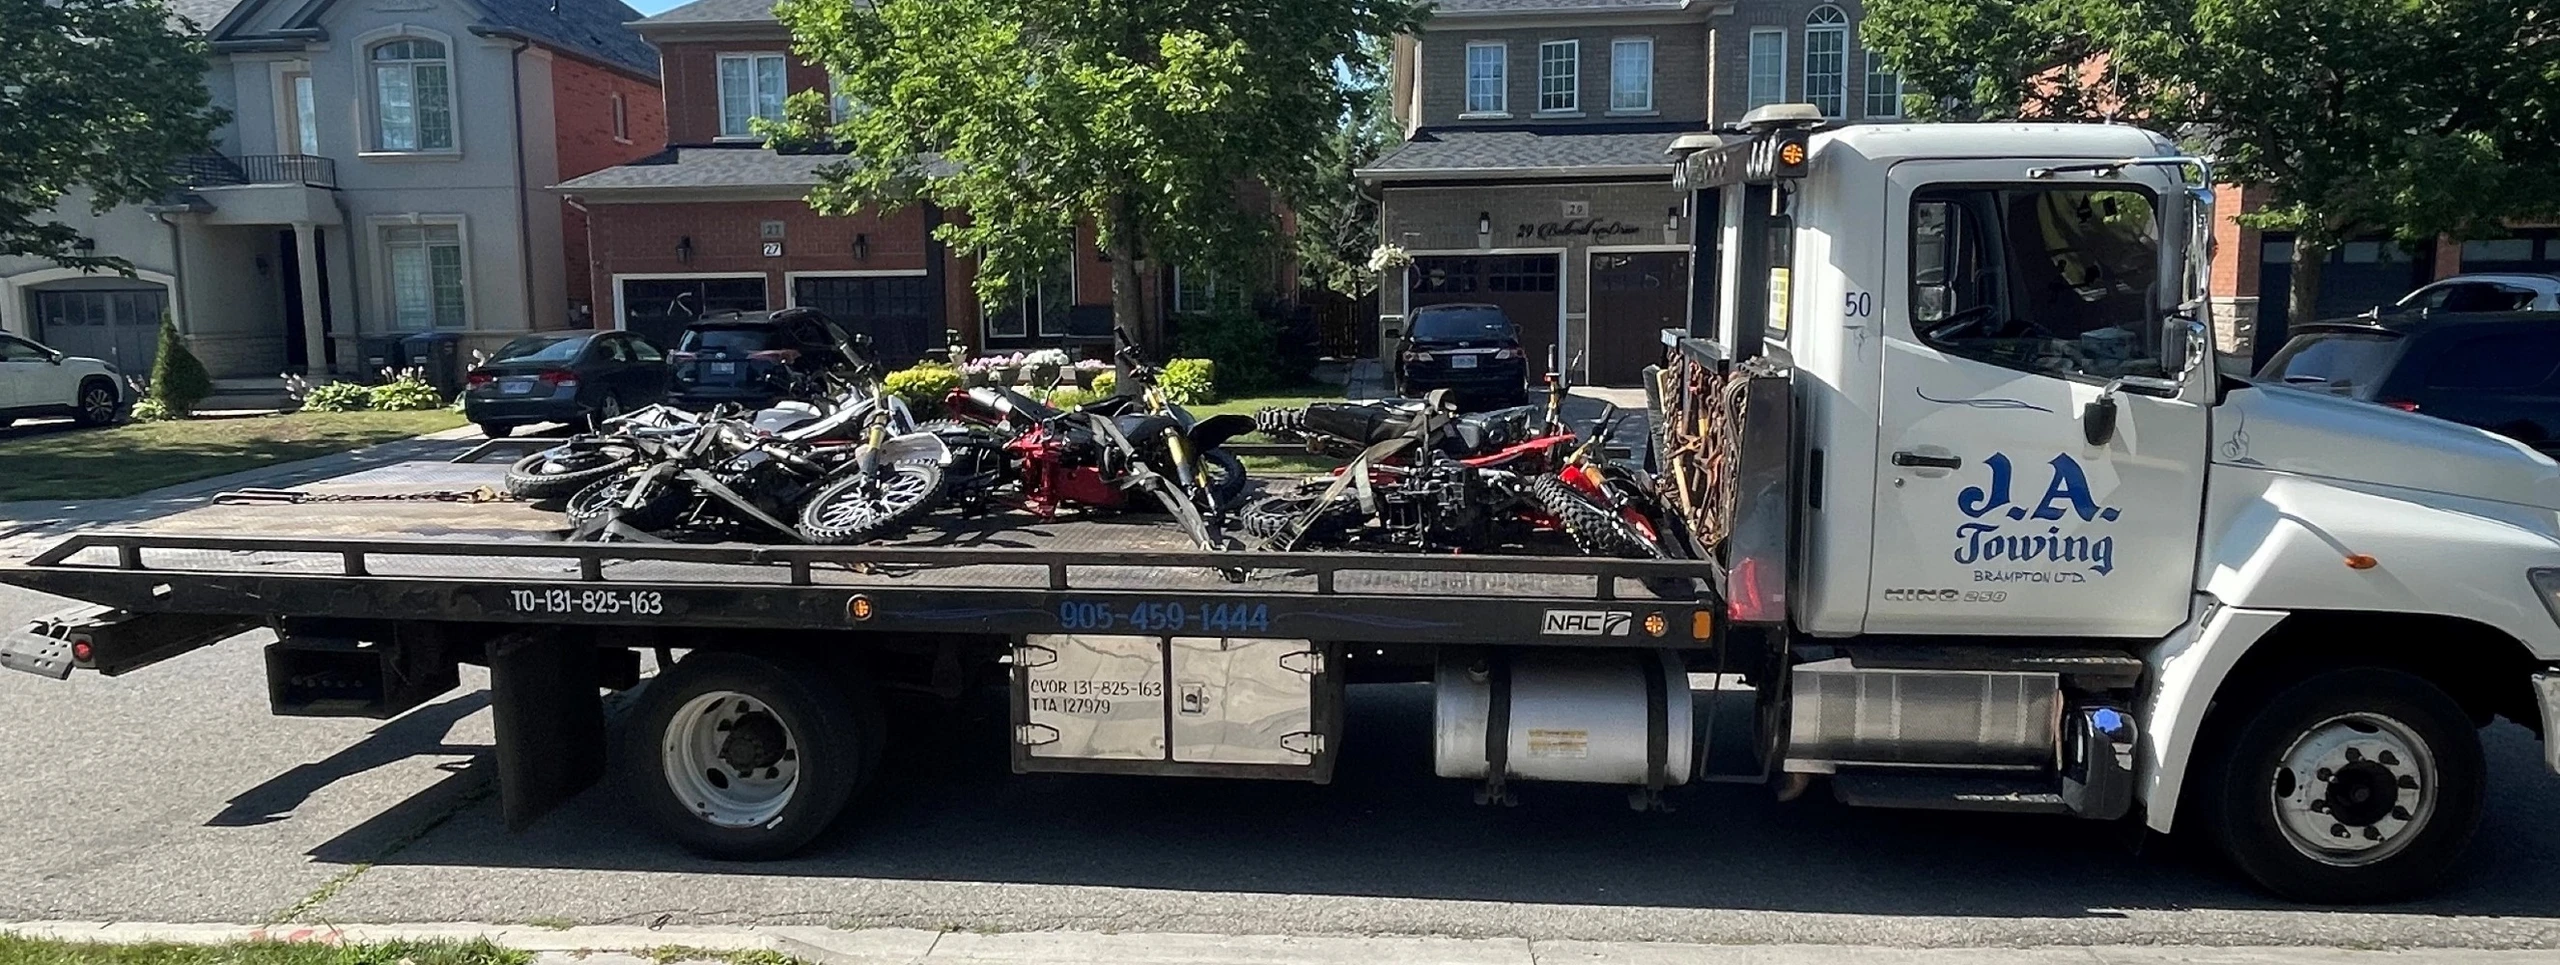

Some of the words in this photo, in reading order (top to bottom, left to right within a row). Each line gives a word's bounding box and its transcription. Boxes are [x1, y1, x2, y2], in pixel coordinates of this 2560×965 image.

[765, 224, 780, 235] 27
[764, 244, 779, 255] 27
[1845, 291, 1872, 318] 50
[1957, 451, 2122, 522] J.A.
[1954, 522, 2114, 577] Towing
[1973, 570, 2050, 584] BRAMPTON
[2053, 572, 2086, 583] LTD.
[511, 589, 663, 615] TO-131-825-163
[1883, 588, 1960, 602] HINO
[1060, 601, 1269, 633] 905-459-1444
[1030, 679, 1067, 694] CVOR
[1073, 680, 1163, 697] 131-825-163
[1031, 698, 1058, 711] TTA
[1063, 698, 1111, 714] 127979
